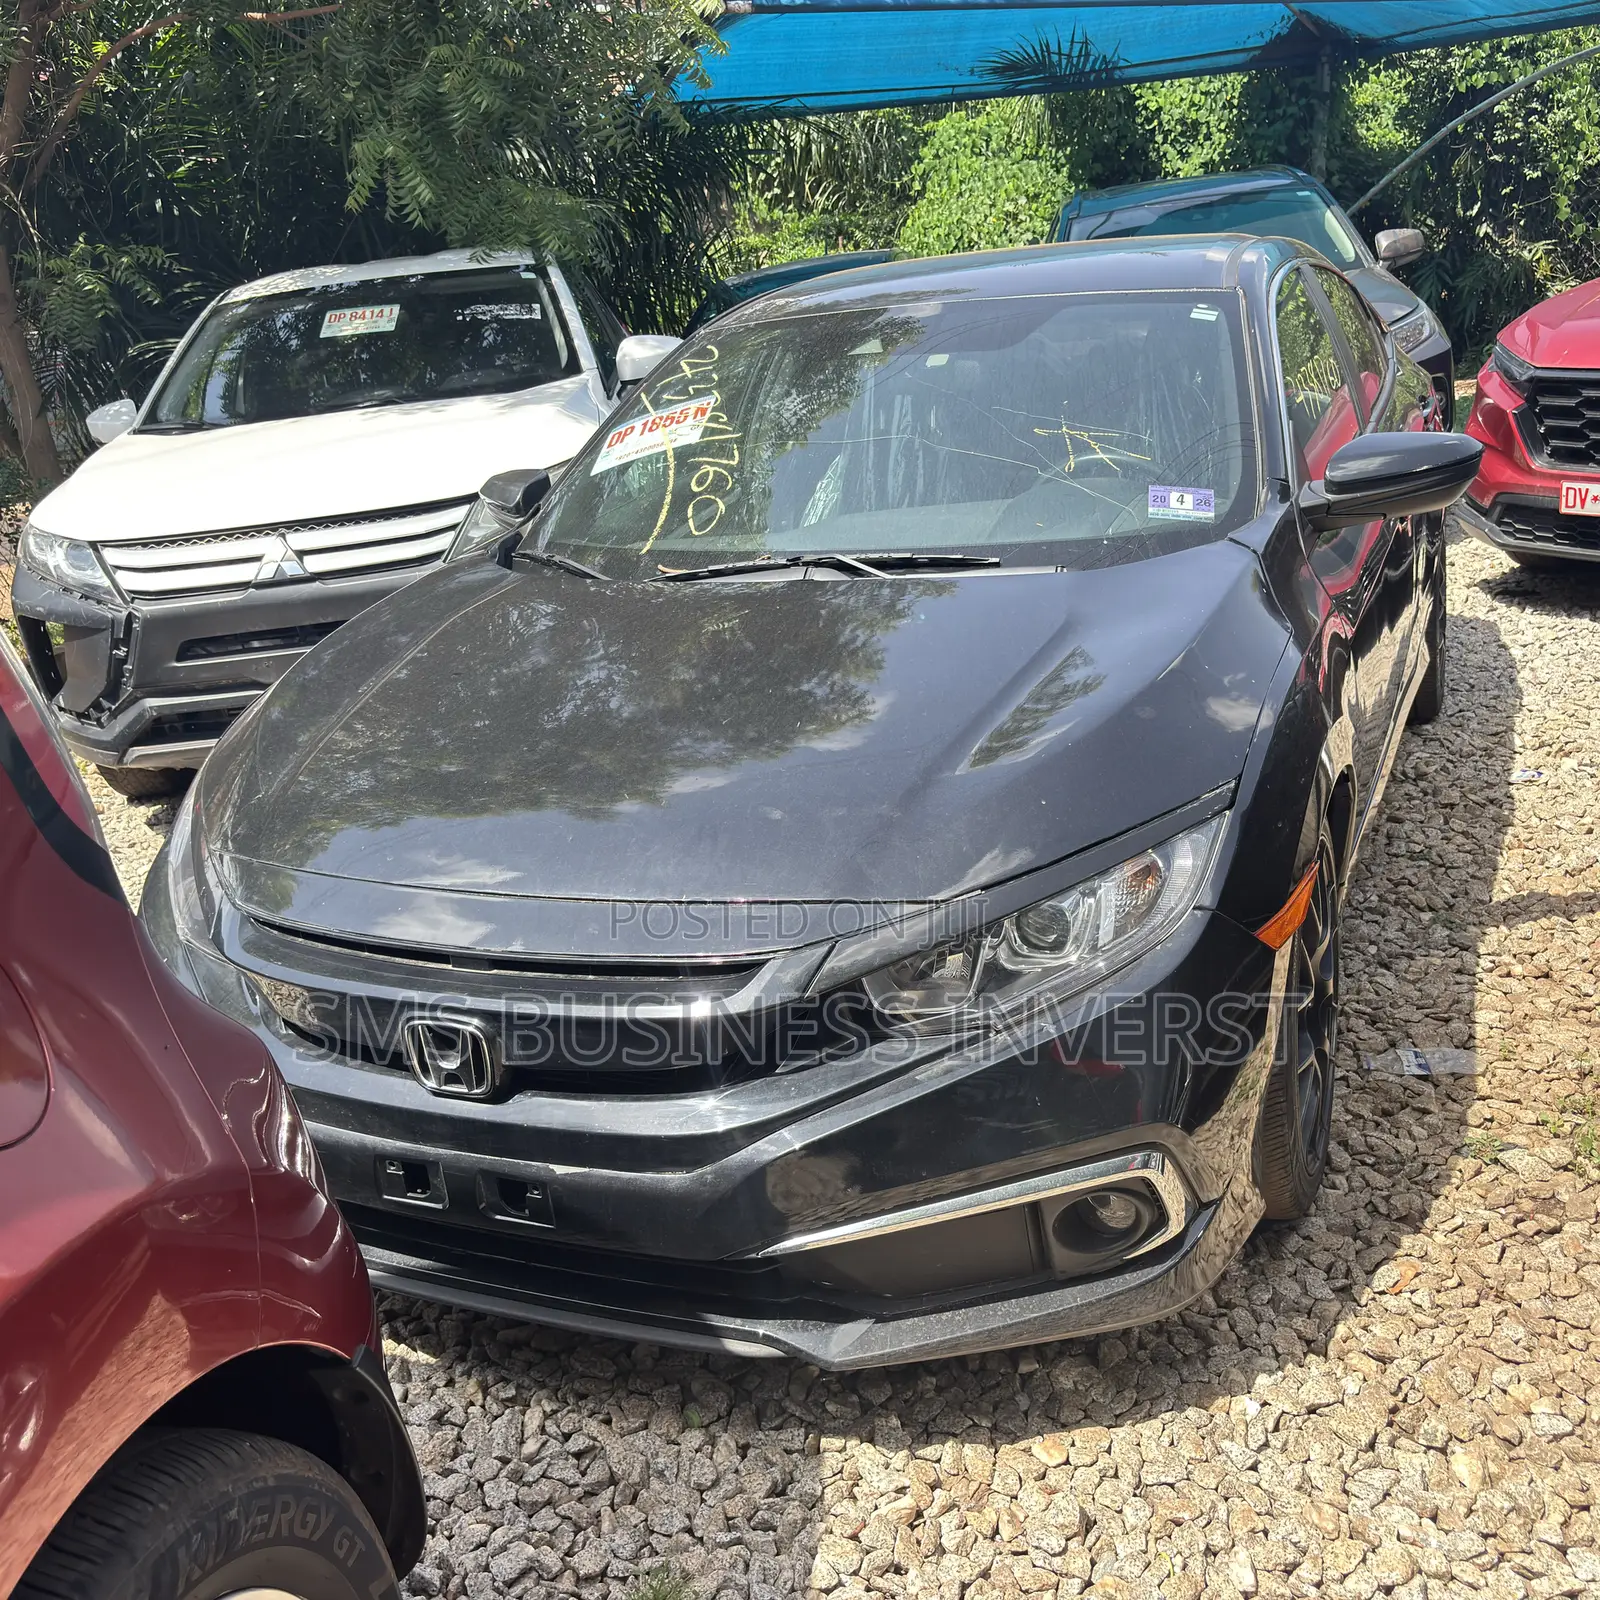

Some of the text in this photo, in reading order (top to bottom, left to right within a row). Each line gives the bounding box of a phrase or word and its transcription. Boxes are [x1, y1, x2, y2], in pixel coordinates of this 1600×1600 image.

[328, 313, 346, 323] DP
[349, 308, 385, 321] 8414
[606, 425, 635, 449] DP
[638, 407, 690, 436] 1855
[1152, 493, 1212, 508] 20 4 26
[332, 1525, 366, 1568] GT
